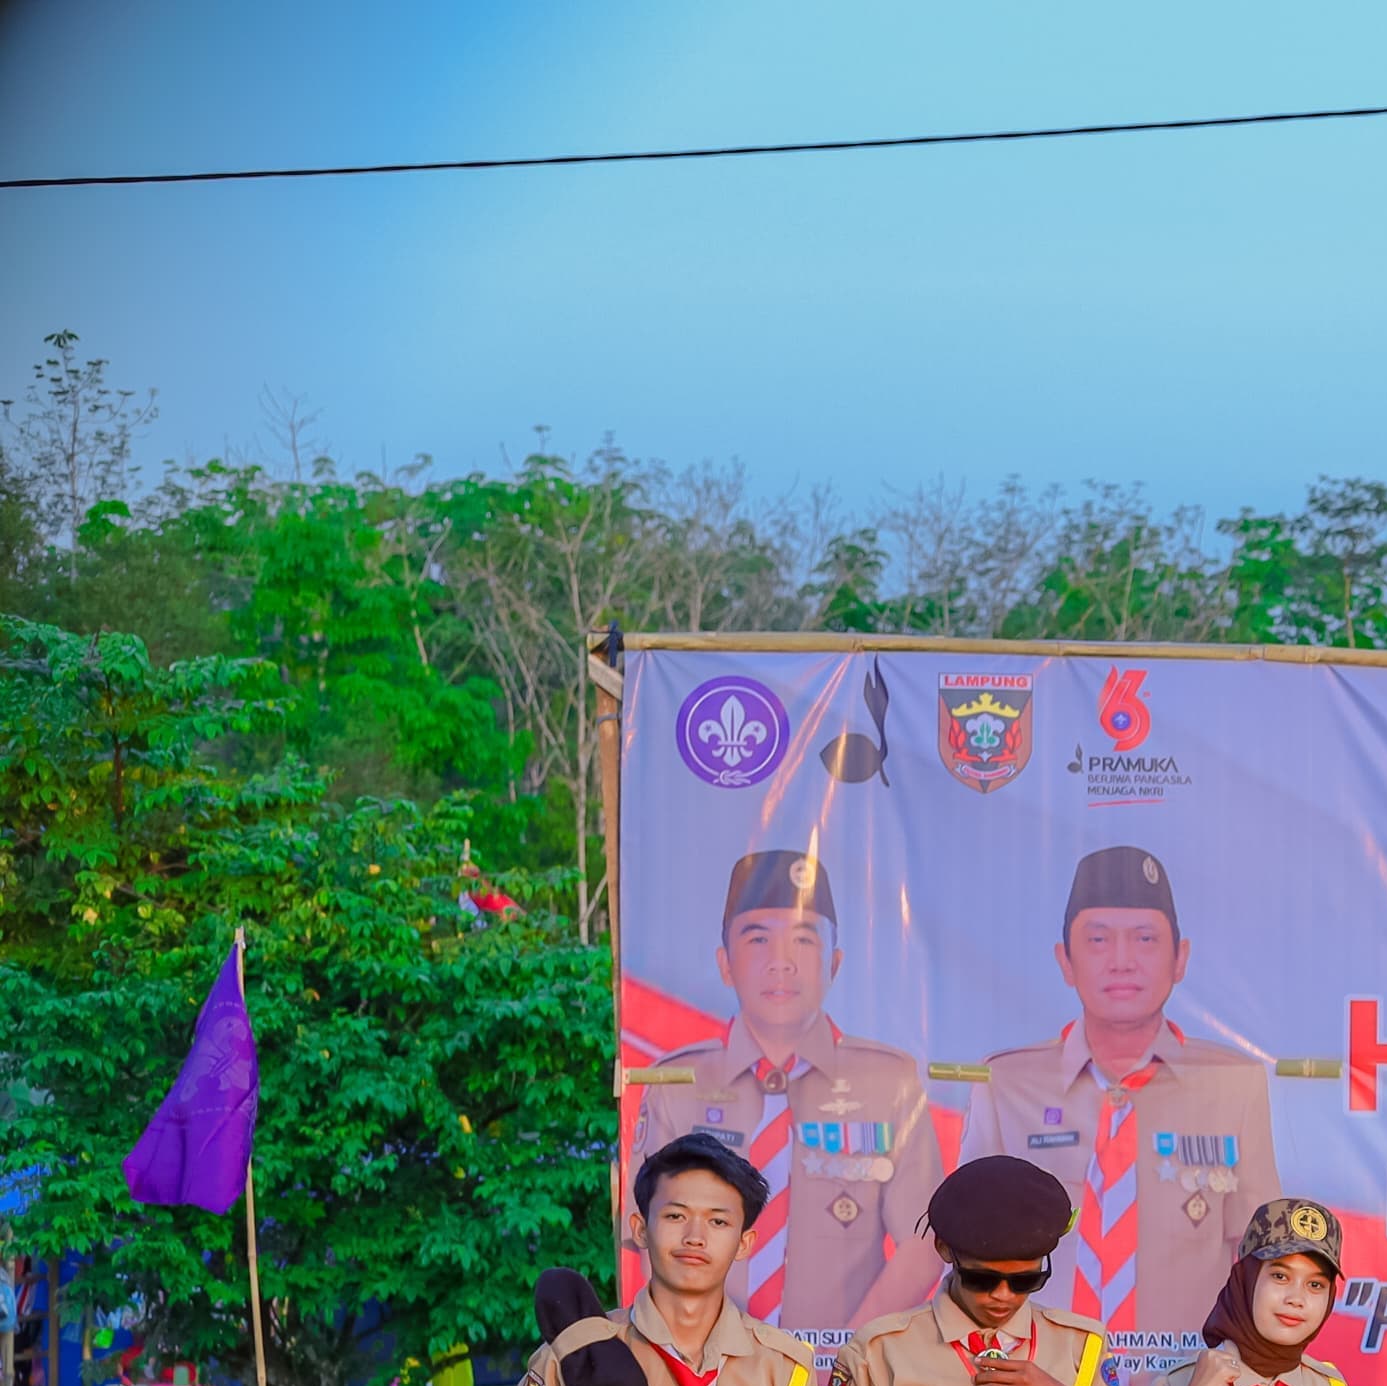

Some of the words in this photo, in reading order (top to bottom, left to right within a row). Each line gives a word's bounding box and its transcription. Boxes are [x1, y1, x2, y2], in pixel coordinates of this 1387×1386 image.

[944, 675, 1028, 688] LAMPUNG
[1088, 755, 1179, 773] PRAMUKA
[1088, 774, 1132, 785] BERJIWA
[1134, 775, 1192, 785] PANCASILA
[1088, 786, 1136, 796] MENJAGA
[1139, 787, 1164, 797] NKRI
